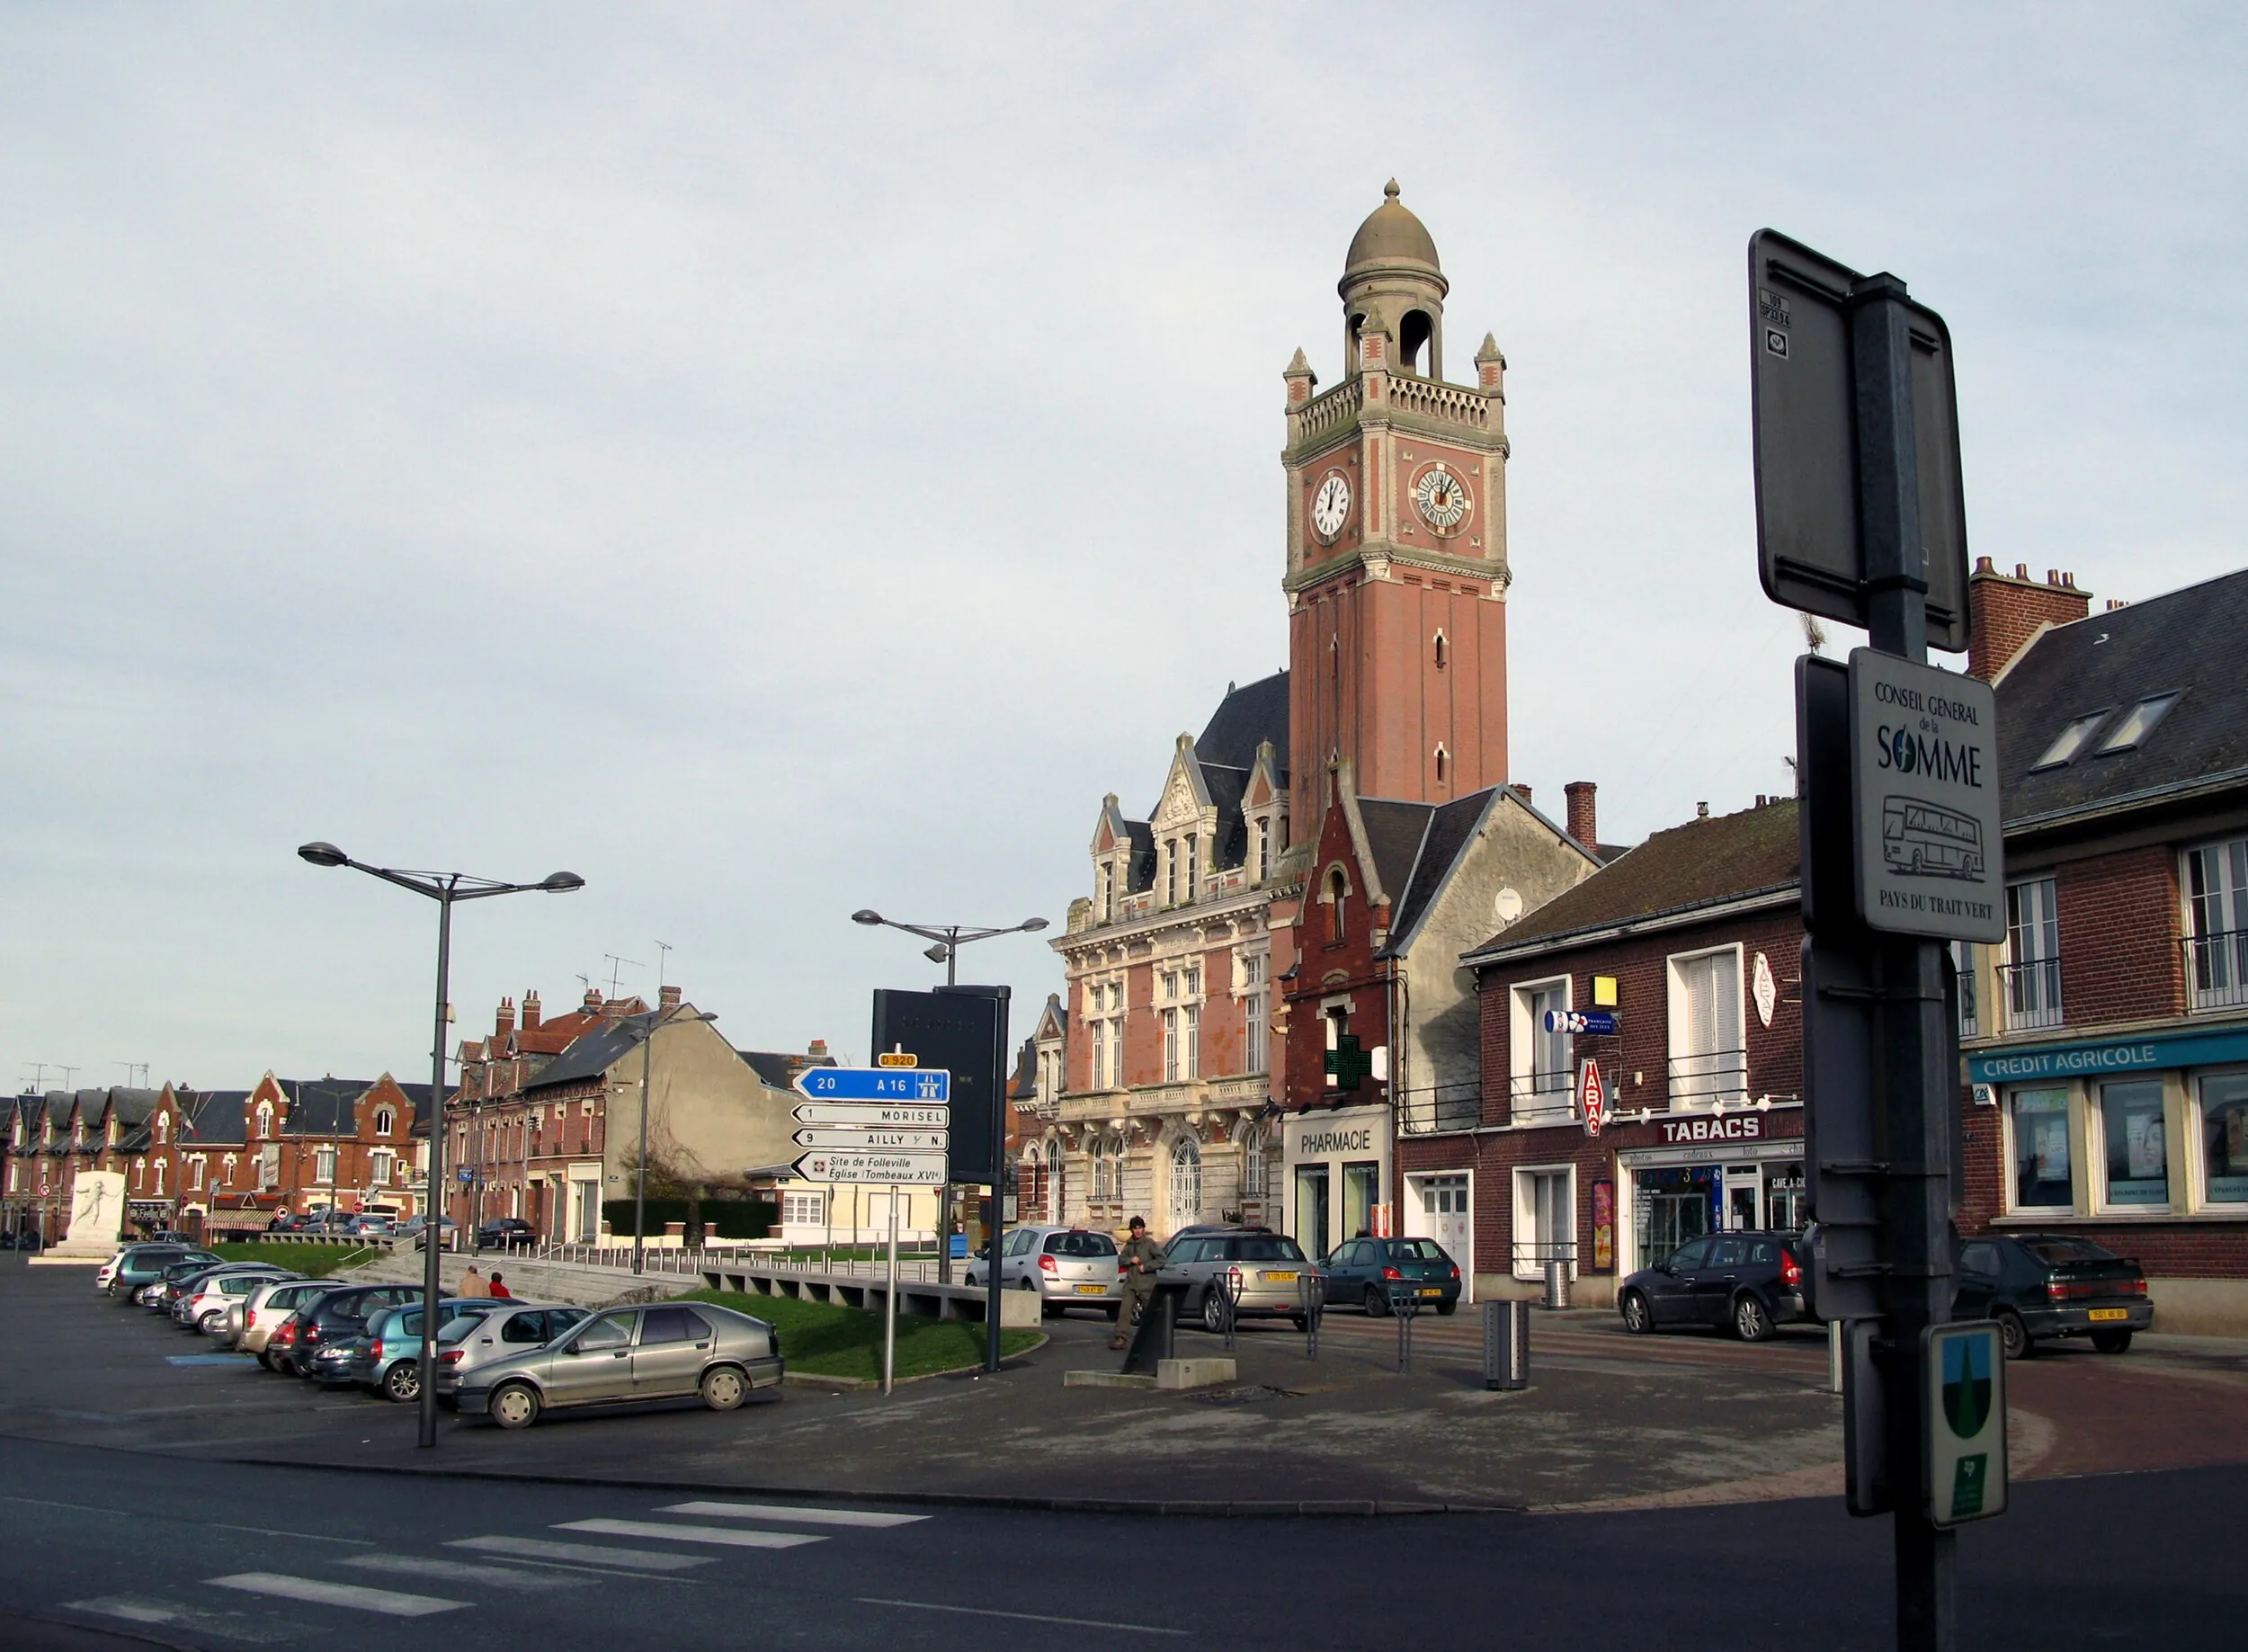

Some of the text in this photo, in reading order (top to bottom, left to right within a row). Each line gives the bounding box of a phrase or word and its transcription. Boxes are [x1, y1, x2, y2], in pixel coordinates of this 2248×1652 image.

[1875, 682, 1979, 726] CONSEIL GENERAL
[1919, 719, 1939, 734] de la
[1878, 724, 1982, 789] SOMME
[1879, 889, 1993, 920] PAYS DU TRAIT VERT
[882, 1056, 914, 1066] D 920
[2055, 1045, 2157, 1070] AGRICOLE
[816, 1077, 906, 1092] 20 A 16
[1585, 1059, 1600, 1136] TABAC
[807, 1109, 942, 1122] 1 MORISEL
[1663, 1117, 1760, 1143] TABACS
[807, 1133, 814, 1143] 9
[867, 1135, 905, 1145] AILLY
[931, 1136, 943, 1146] N.
[1301, 1130, 1371, 1153] PHARMACIE
[829, 1156, 911, 1168] Site de Folleville
[1629, 1152, 1653, 1165] photos
[1682, 1148, 1714, 1161] cadeaux
[1743, 1145, 1758, 1156] loto
[828, 1167, 859, 1181] Église
[1771, 1177, 1787, 1189] CAVE
